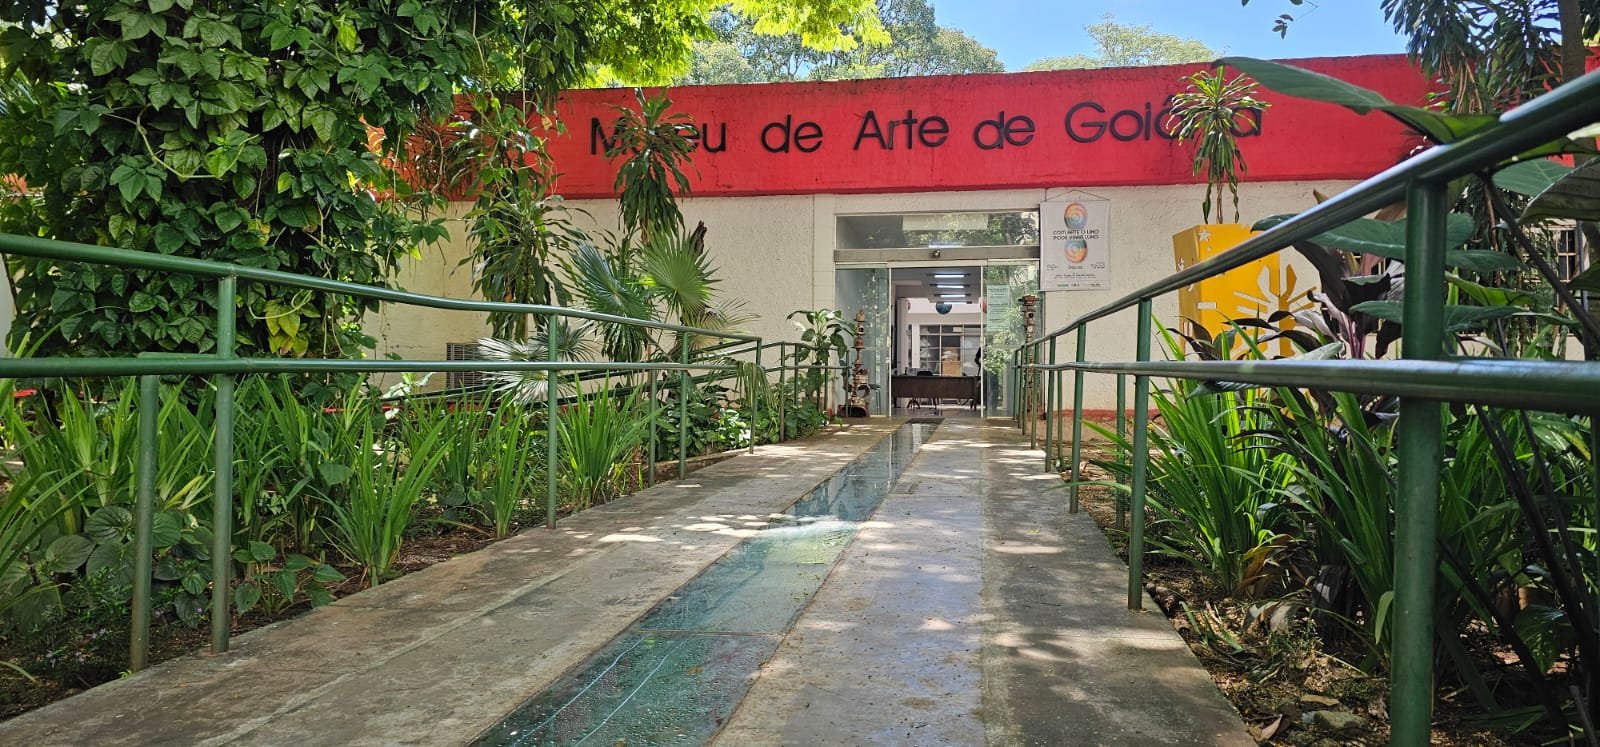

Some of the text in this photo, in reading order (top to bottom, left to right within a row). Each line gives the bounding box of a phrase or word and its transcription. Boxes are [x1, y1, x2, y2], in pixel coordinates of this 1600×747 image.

[591, 95, 1263, 155] Meu de Arte de Goiâa
